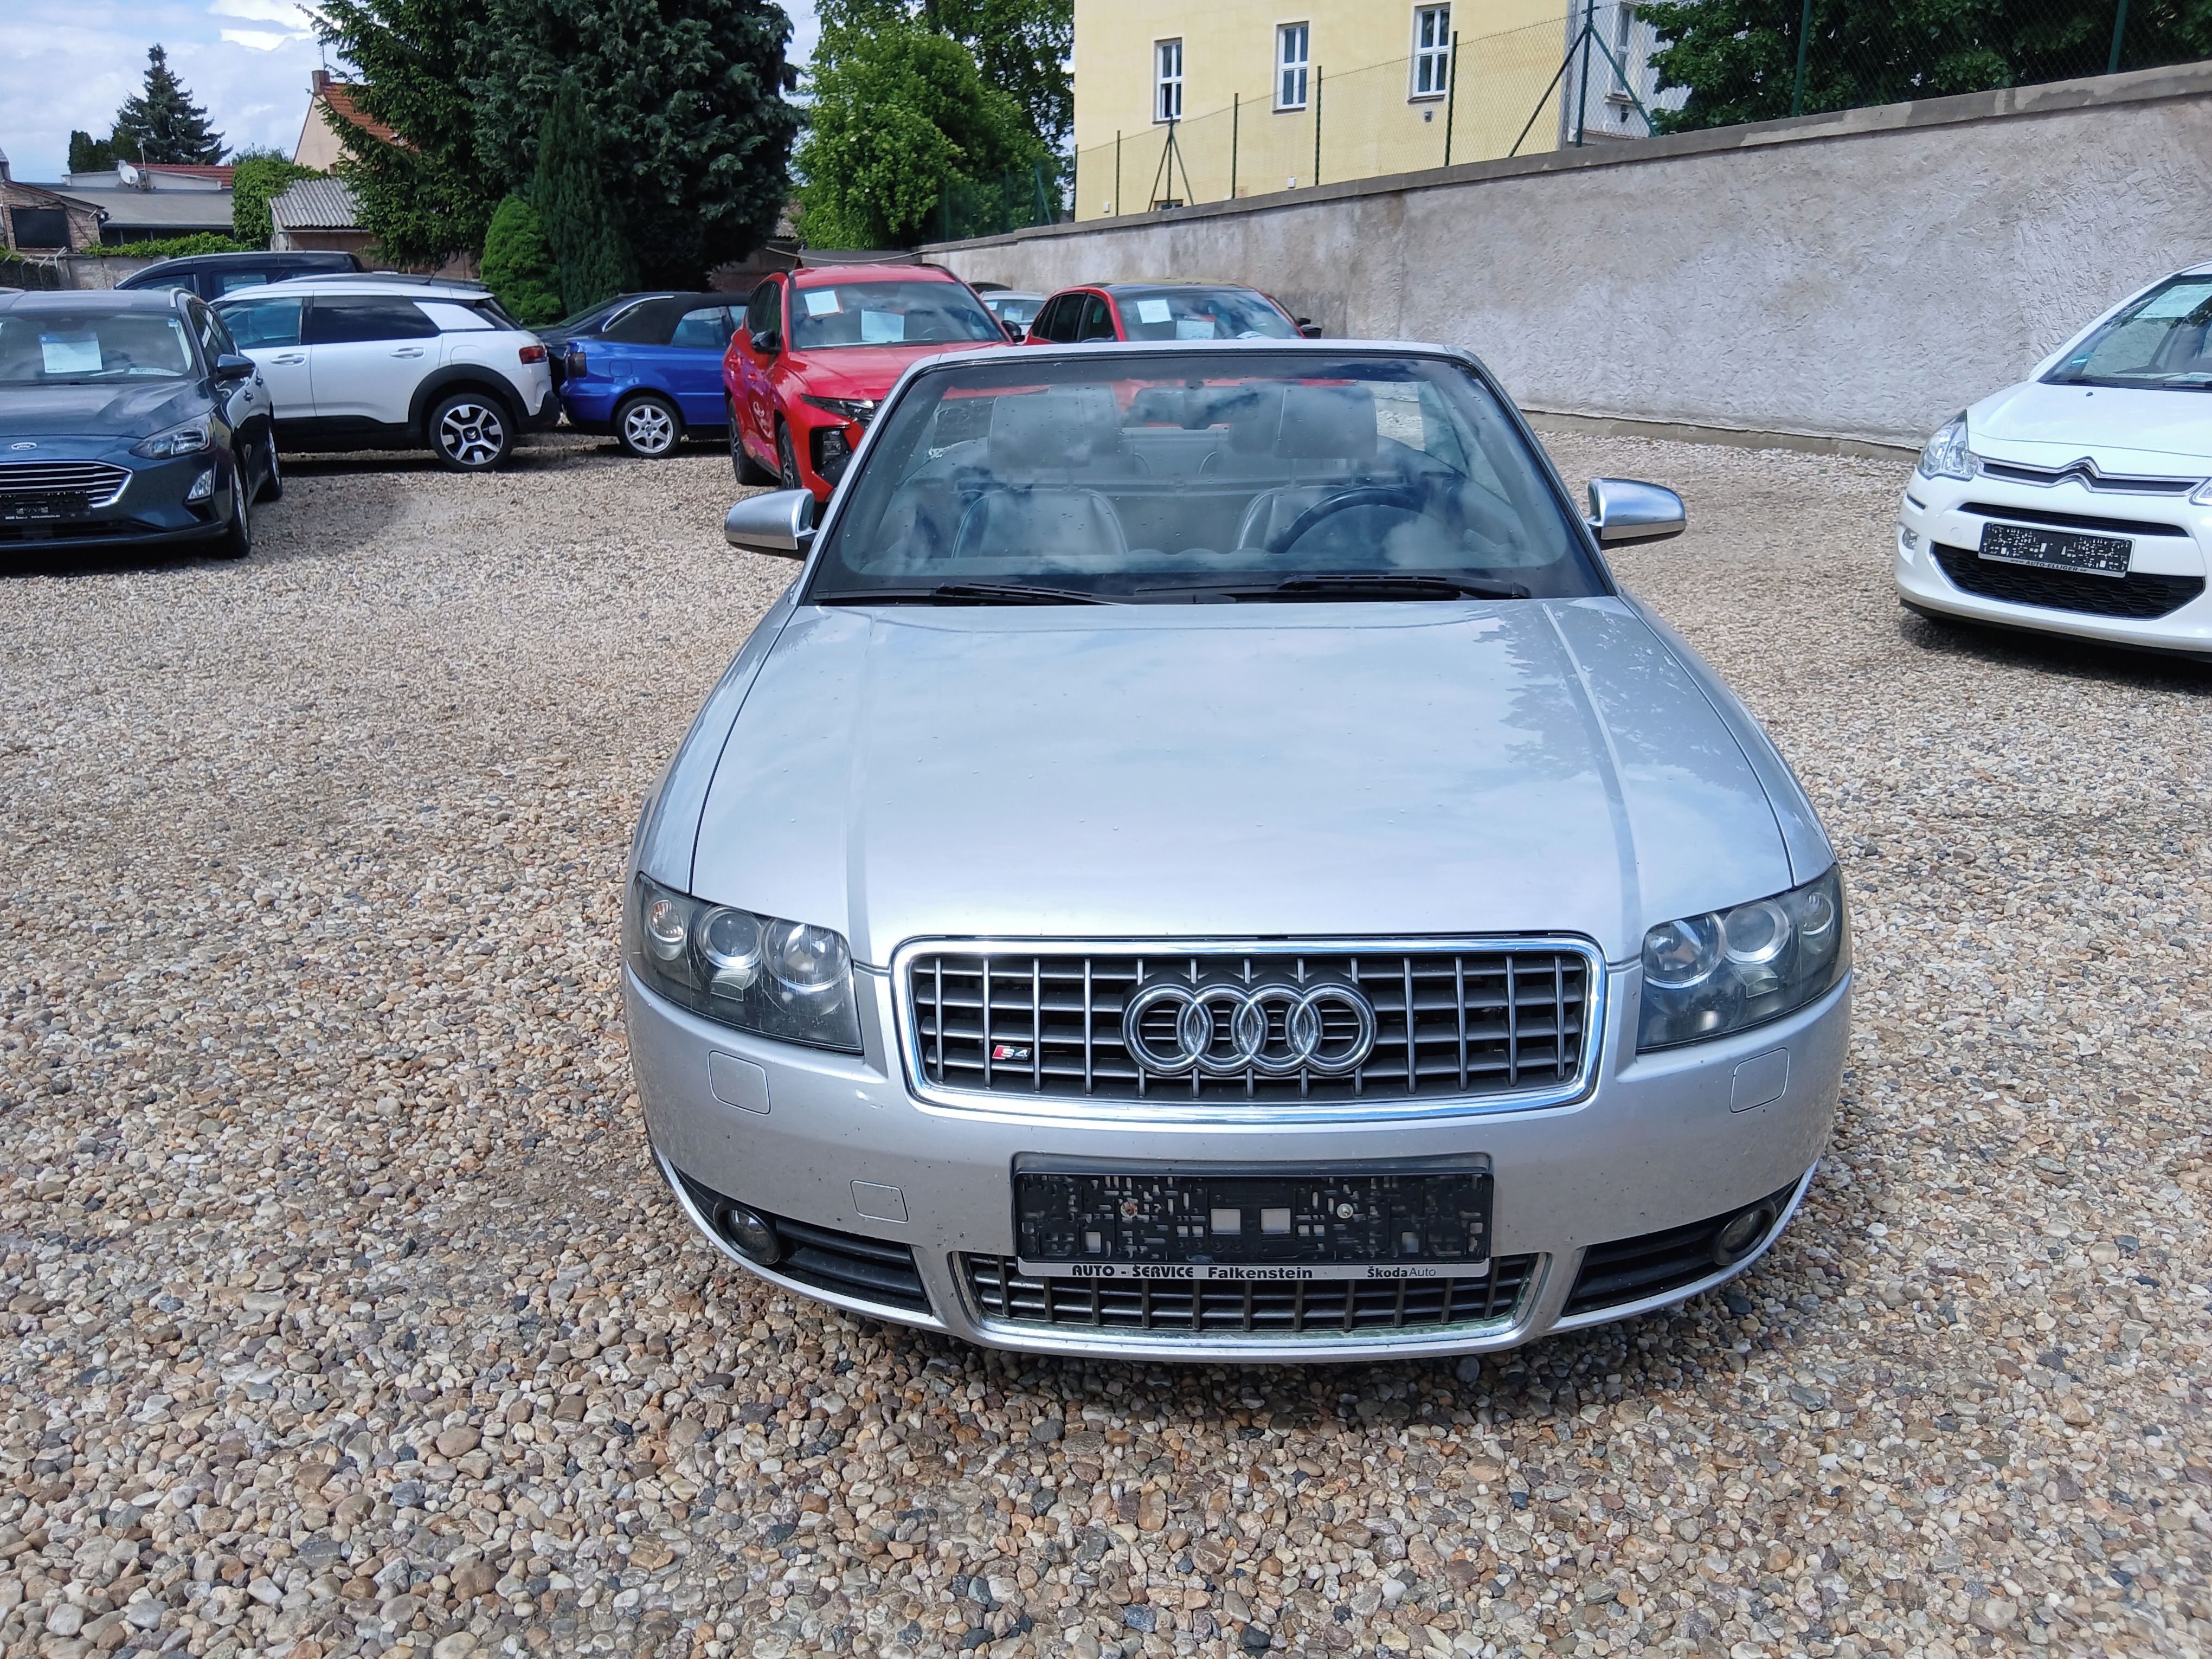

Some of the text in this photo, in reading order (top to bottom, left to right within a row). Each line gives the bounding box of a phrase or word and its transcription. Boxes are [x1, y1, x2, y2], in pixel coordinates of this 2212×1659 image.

[1001, 1048, 1028, 1059] S4
[1072, 1265, 1115, 1277] AUTO
[1132, 1265, 1194, 1278] SERVICE
[1207, 1266, 1313, 1279] Falkenstein
